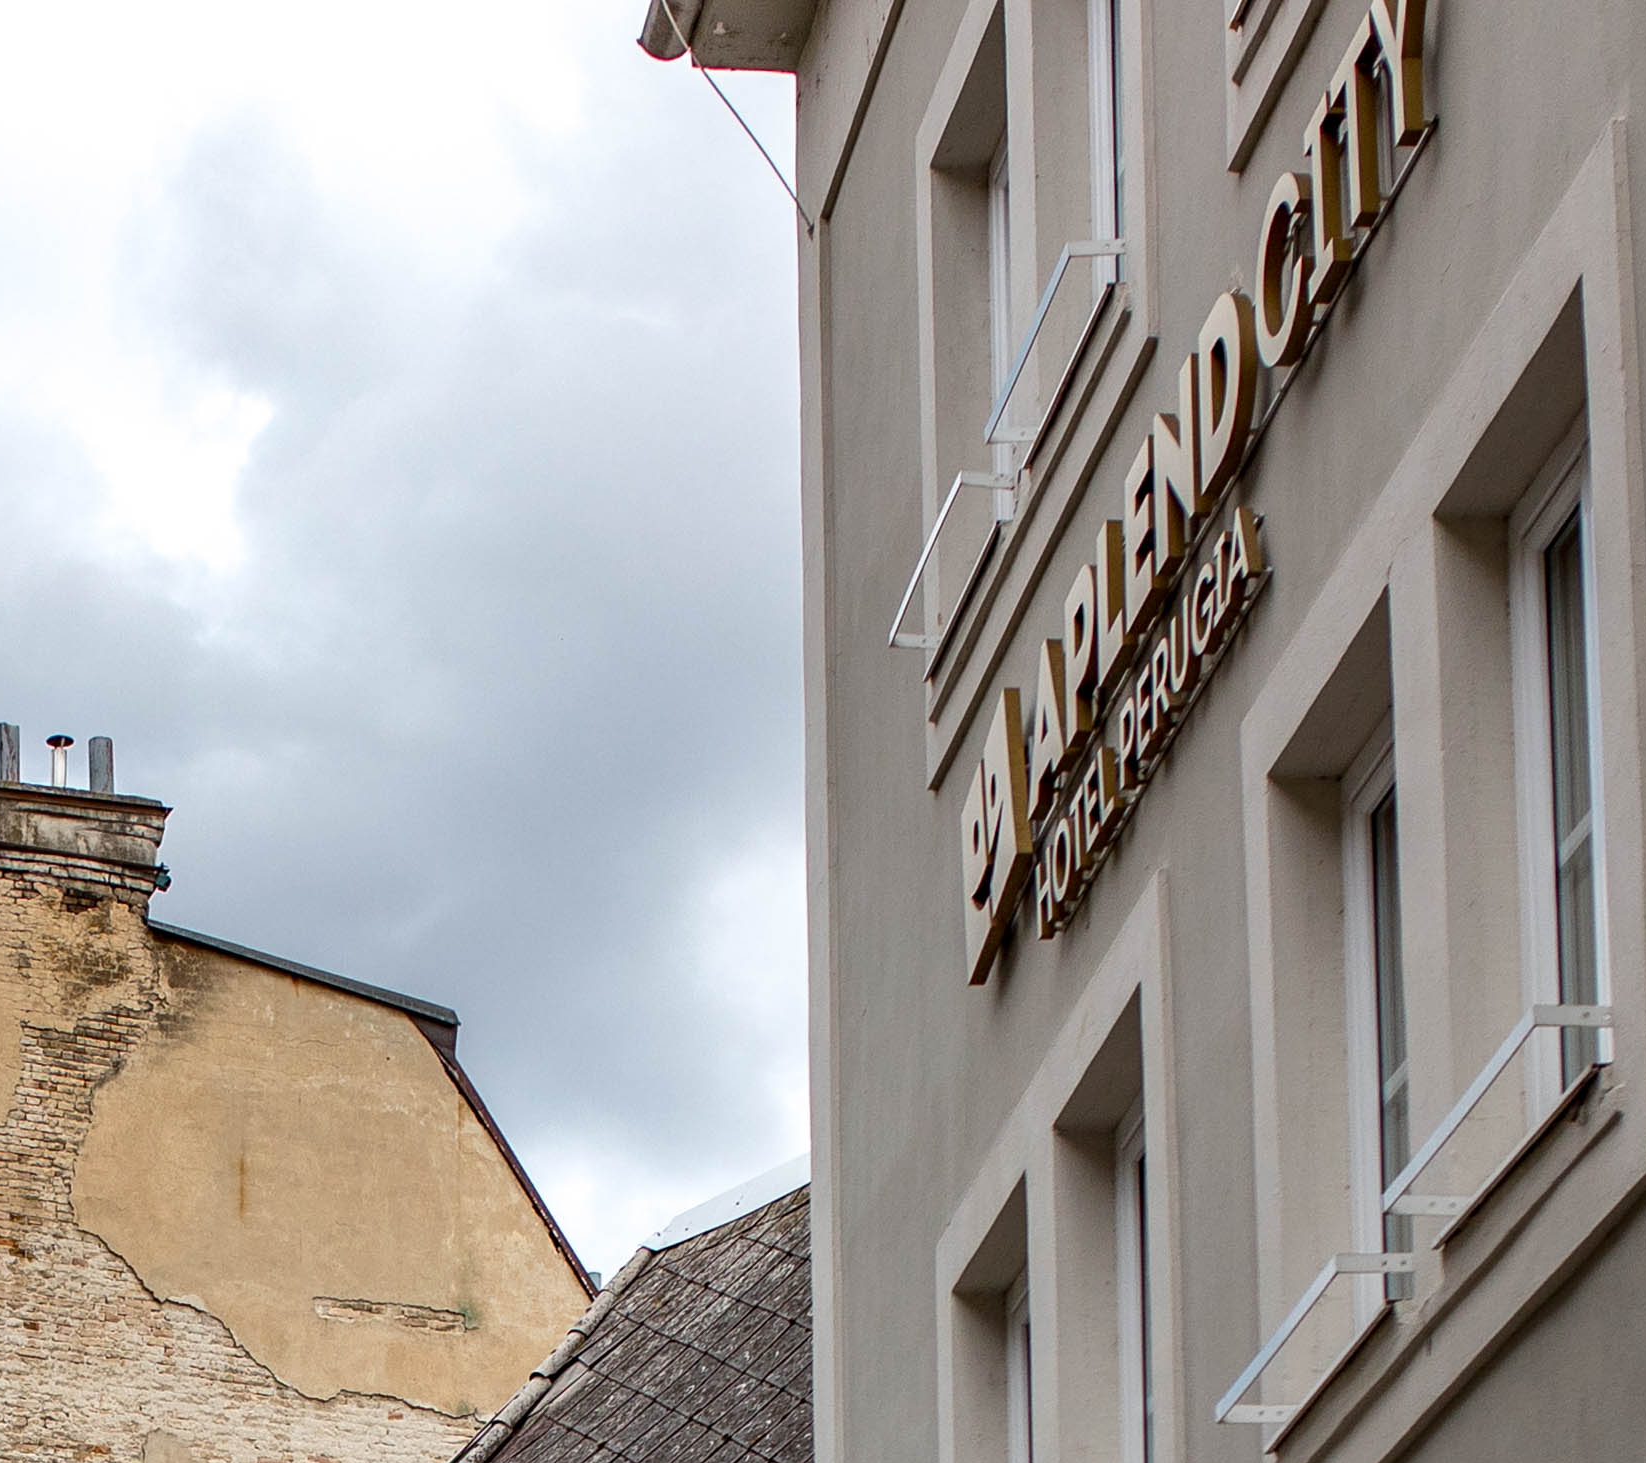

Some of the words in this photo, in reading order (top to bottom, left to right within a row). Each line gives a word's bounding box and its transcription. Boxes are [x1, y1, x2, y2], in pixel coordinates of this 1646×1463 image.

[1027, 288, 1257, 822] APLEND
[1254, 0, 1426, 369] CITY
[1035, 746, 1121, 942] HOTEL
[1118, 505, 1266, 792] PERUGIA
